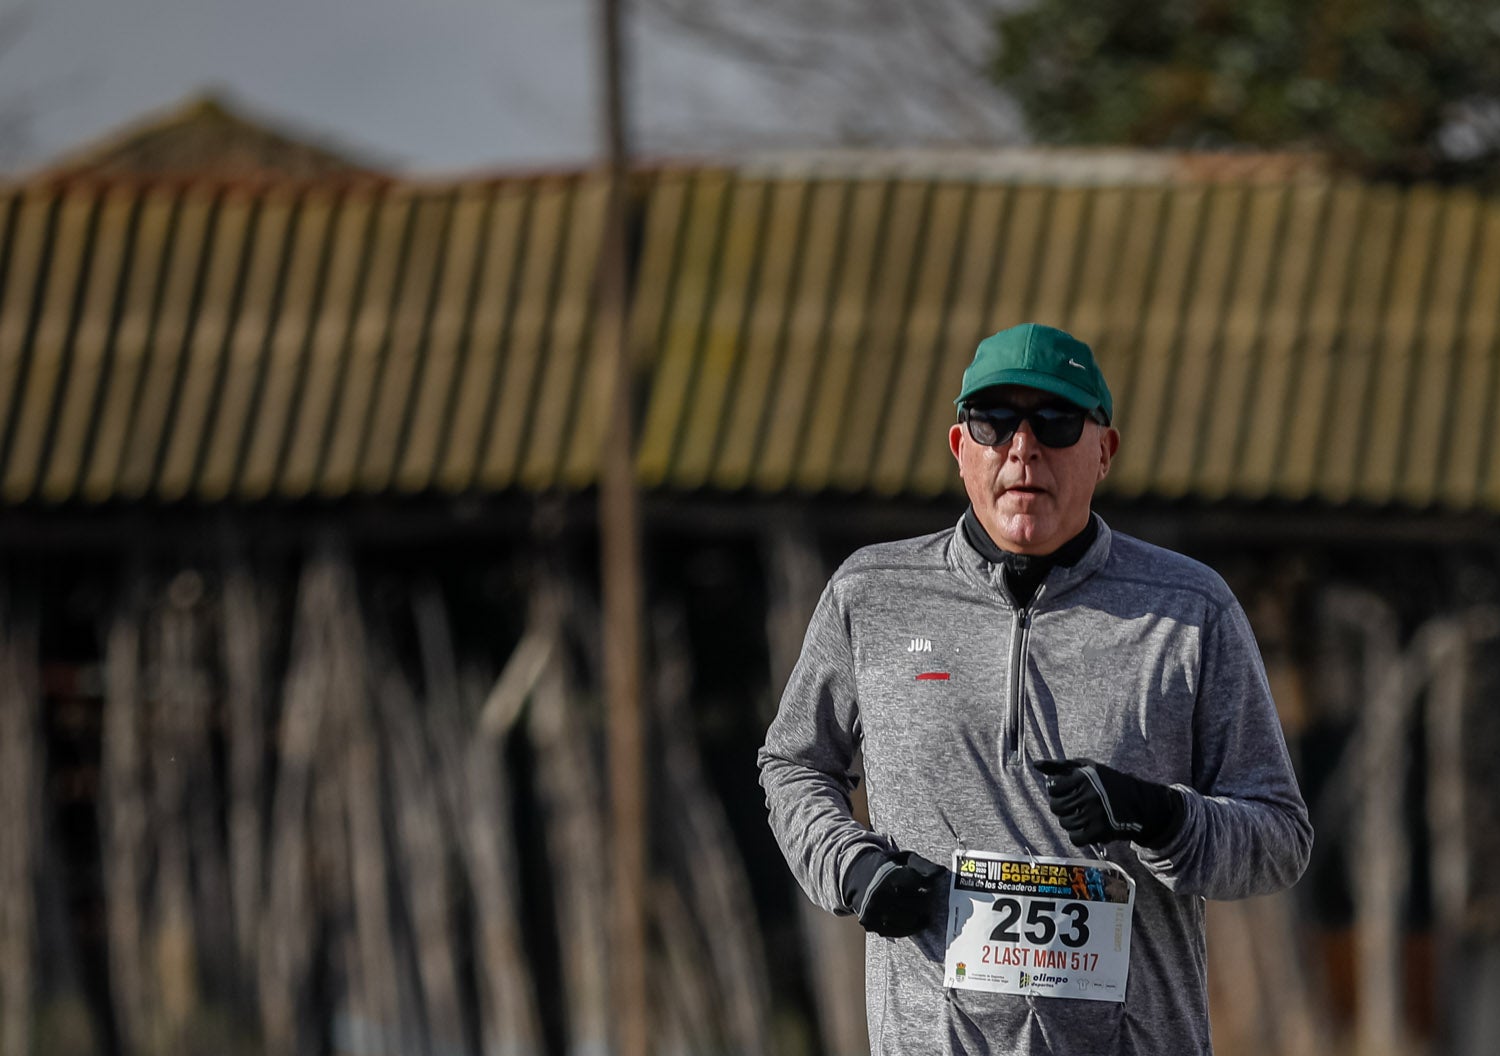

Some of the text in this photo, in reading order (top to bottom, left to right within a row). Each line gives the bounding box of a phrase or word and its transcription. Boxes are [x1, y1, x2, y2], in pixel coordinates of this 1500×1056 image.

[961, 860, 976, 872] 26
[987, 861, 1068, 880] VII CARRERA
[960, 878, 1037, 893] Ruta de los Secaderos
[1001, 873, 1068, 886] POPULAR
[989, 898, 1090, 948] 253
[982, 945, 1099, 972] 2 LAST MAN 517
[1033, 973, 1069, 985] olimpo
